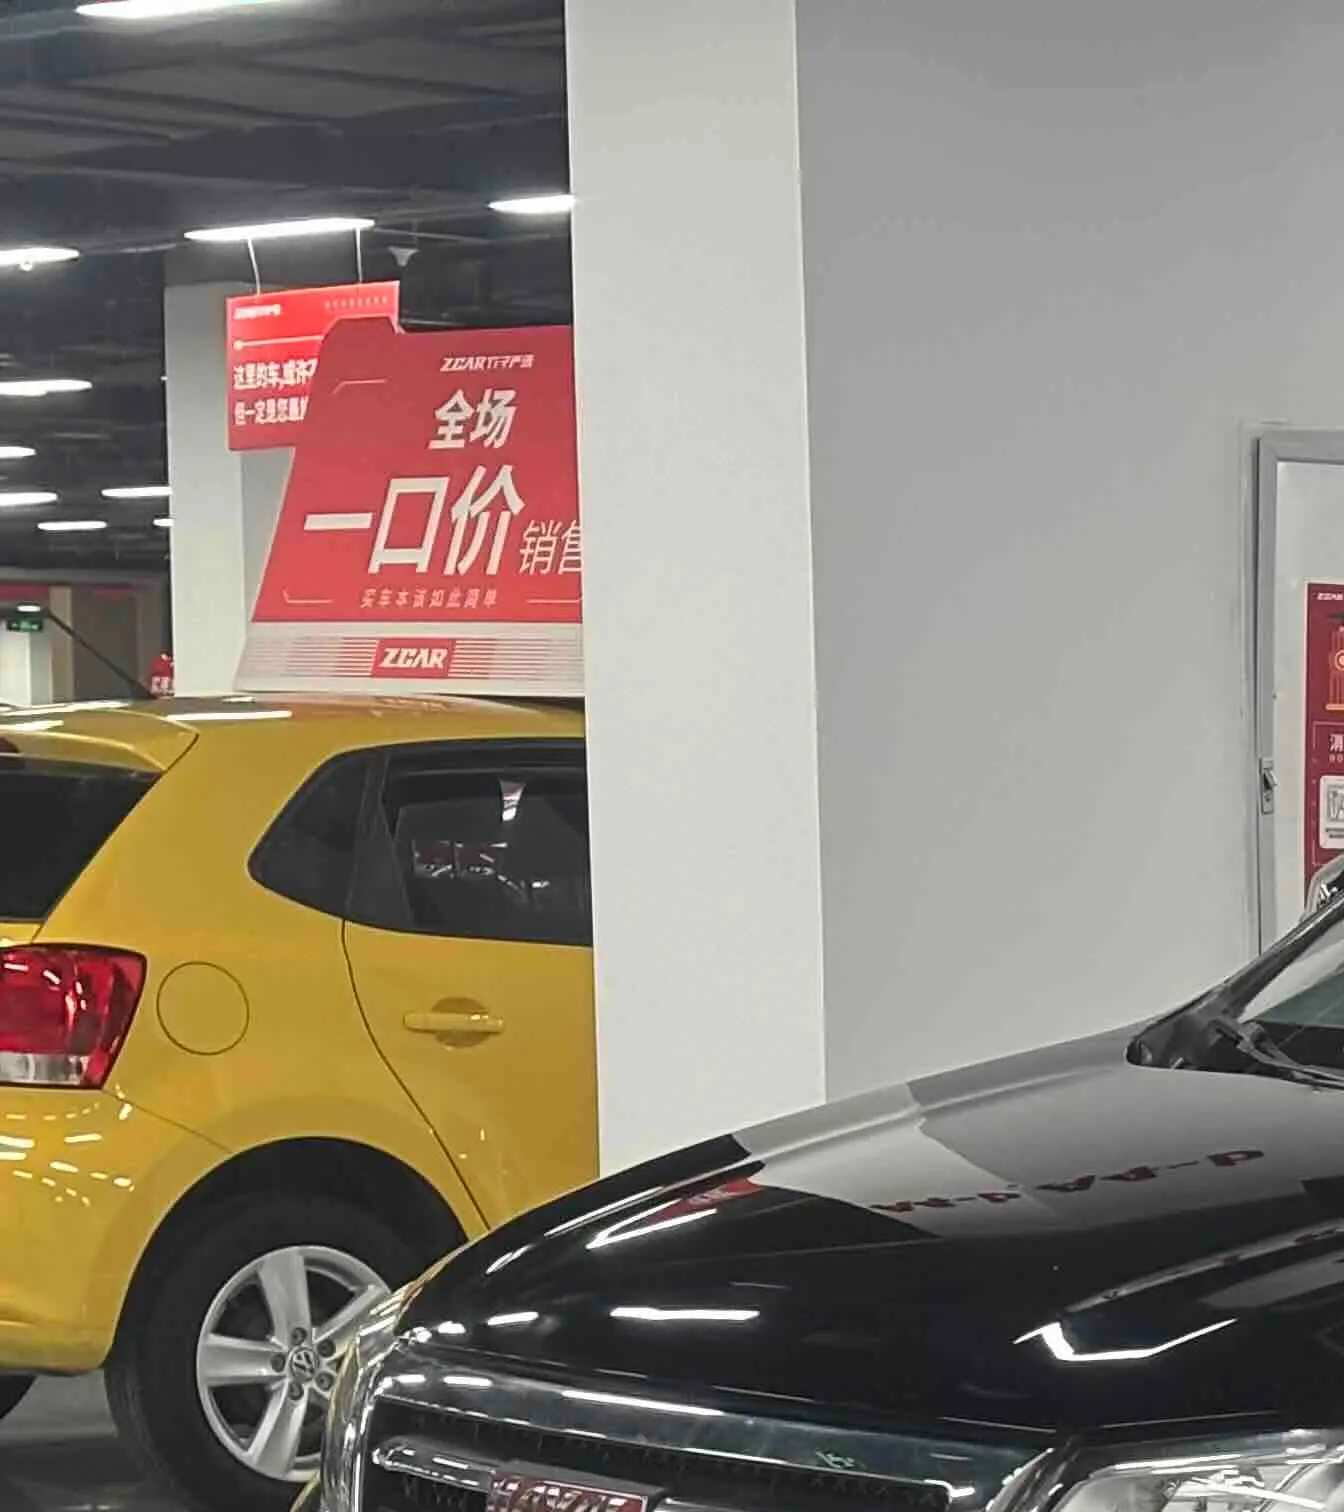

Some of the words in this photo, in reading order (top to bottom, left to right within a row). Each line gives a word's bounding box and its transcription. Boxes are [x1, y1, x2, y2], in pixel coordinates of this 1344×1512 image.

[428, 388, 519, 450] 全场
[304, 465, 526, 576] 一口价
[379, 647, 448, 669] ZCAR
